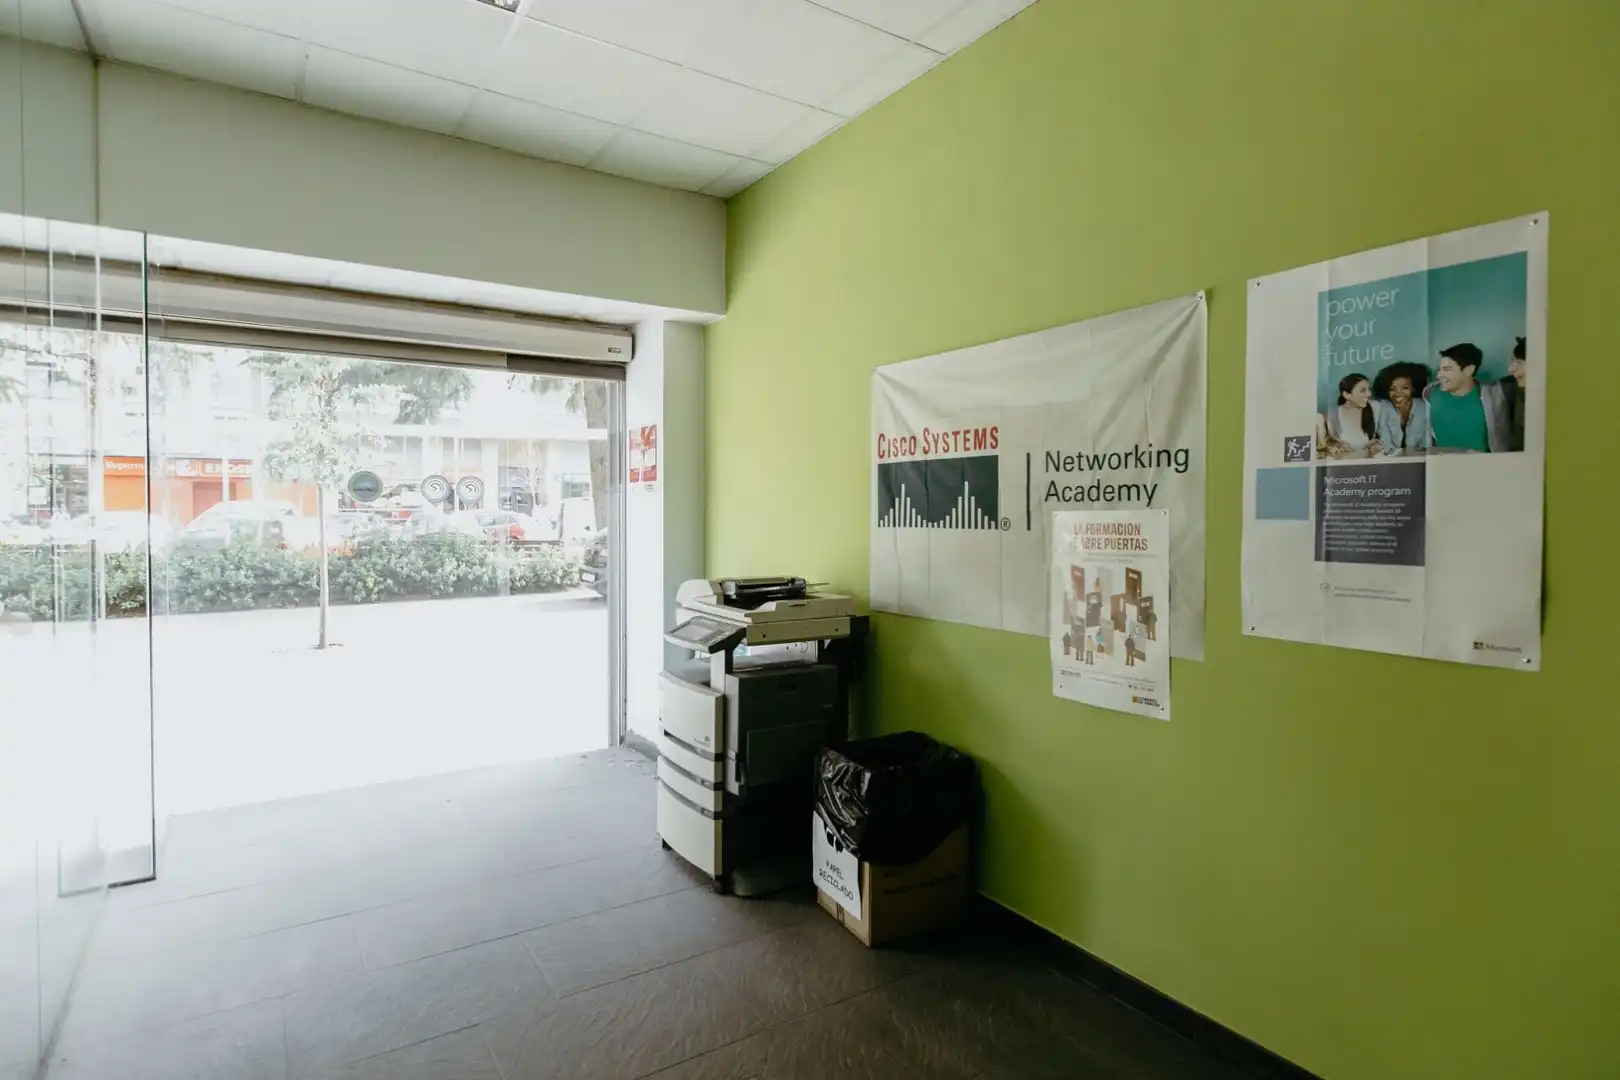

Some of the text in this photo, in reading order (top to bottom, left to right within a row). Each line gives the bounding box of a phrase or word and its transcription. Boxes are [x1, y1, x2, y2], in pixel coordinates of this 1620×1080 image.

[1326, 287, 1400, 322] power
[1325, 318, 1377, 343] your
[1325, 342, 1395, 367] future
[1045, 444, 1190, 474] Networking
[1324, 474, 1378, 485] Microsoft IT
[1044, 478, 1158, 507] Academy
[1323, 487, 1412, 498] Academy program
[1104, 538, 1149, 551] PUERTAS
[825, 859, 844, 881] PAPEL
[819, 868, 854, 901] RECICLADO
